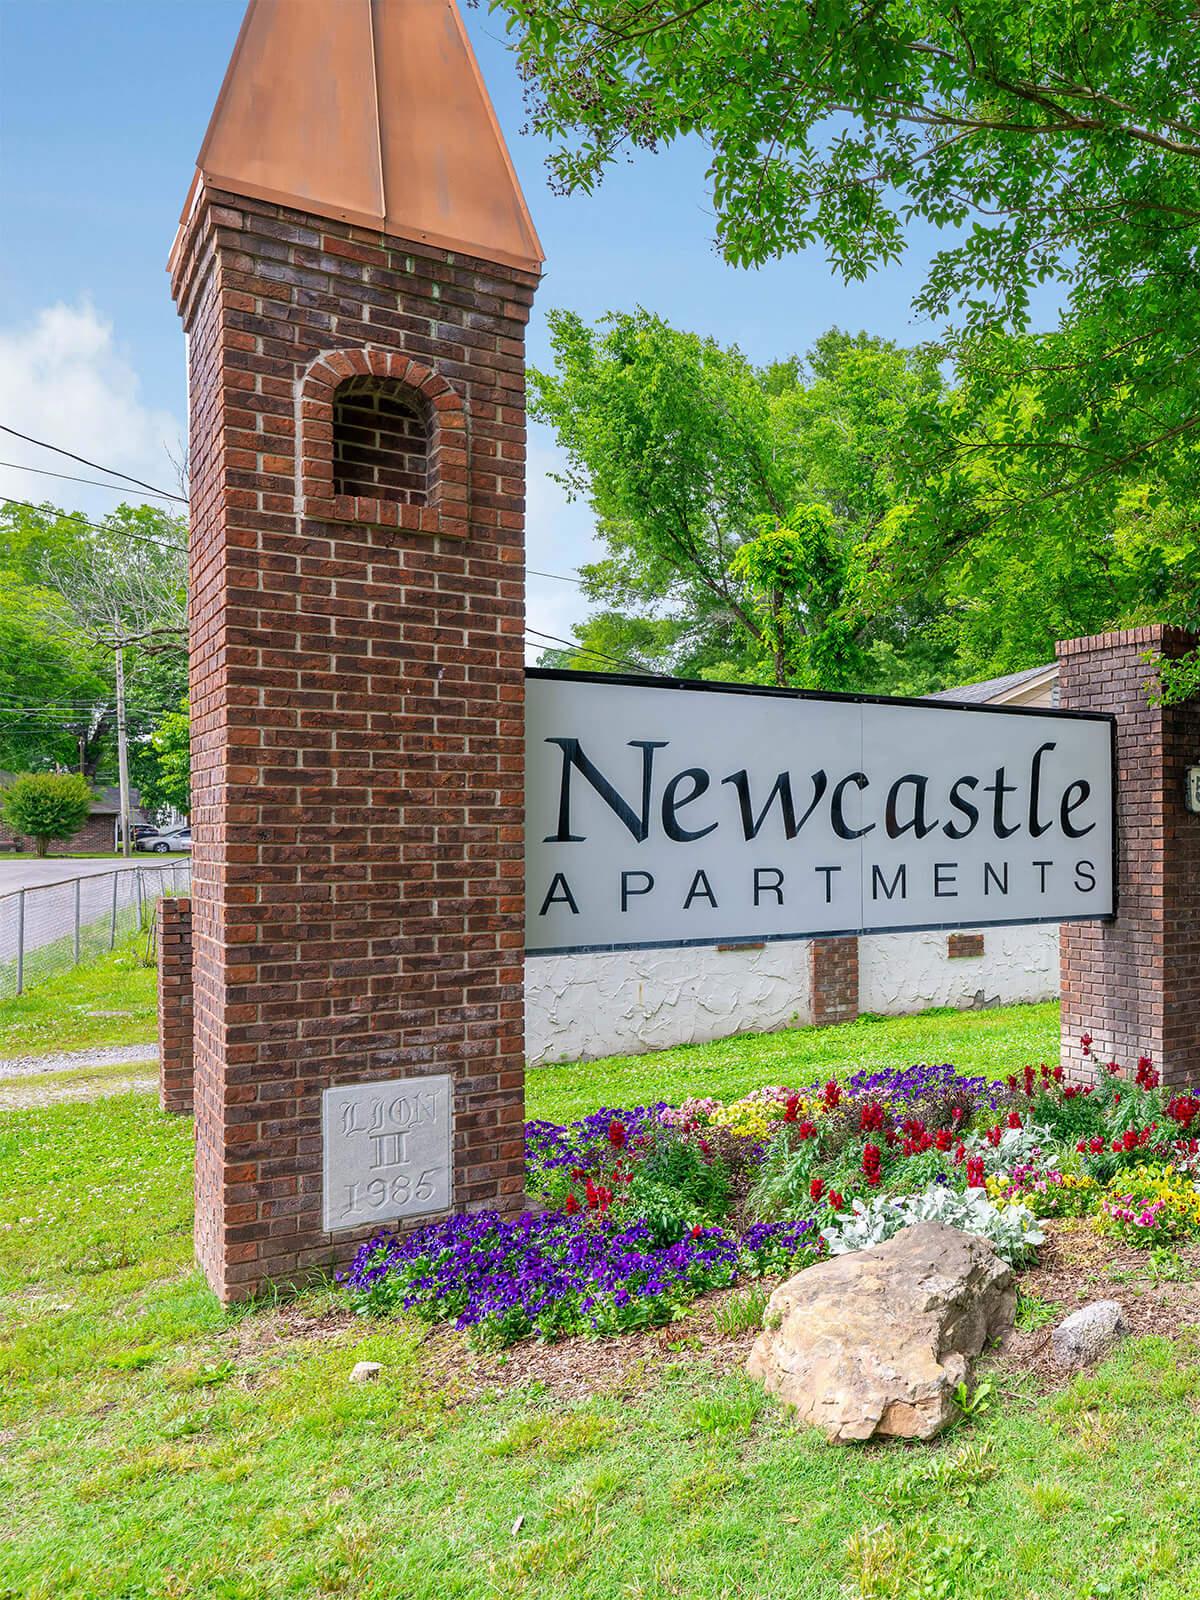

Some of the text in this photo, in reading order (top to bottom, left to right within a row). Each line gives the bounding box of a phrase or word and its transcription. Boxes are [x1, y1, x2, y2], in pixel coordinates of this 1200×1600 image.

[542, 736, 1097, 844] Newcastle
[538, 860, 1097, 917] APARTMENTS
[340, 1089, 442, 1137] LION
[369, 1130, 411, 1171] II
[340, 1166, 442, 1219] 1985
